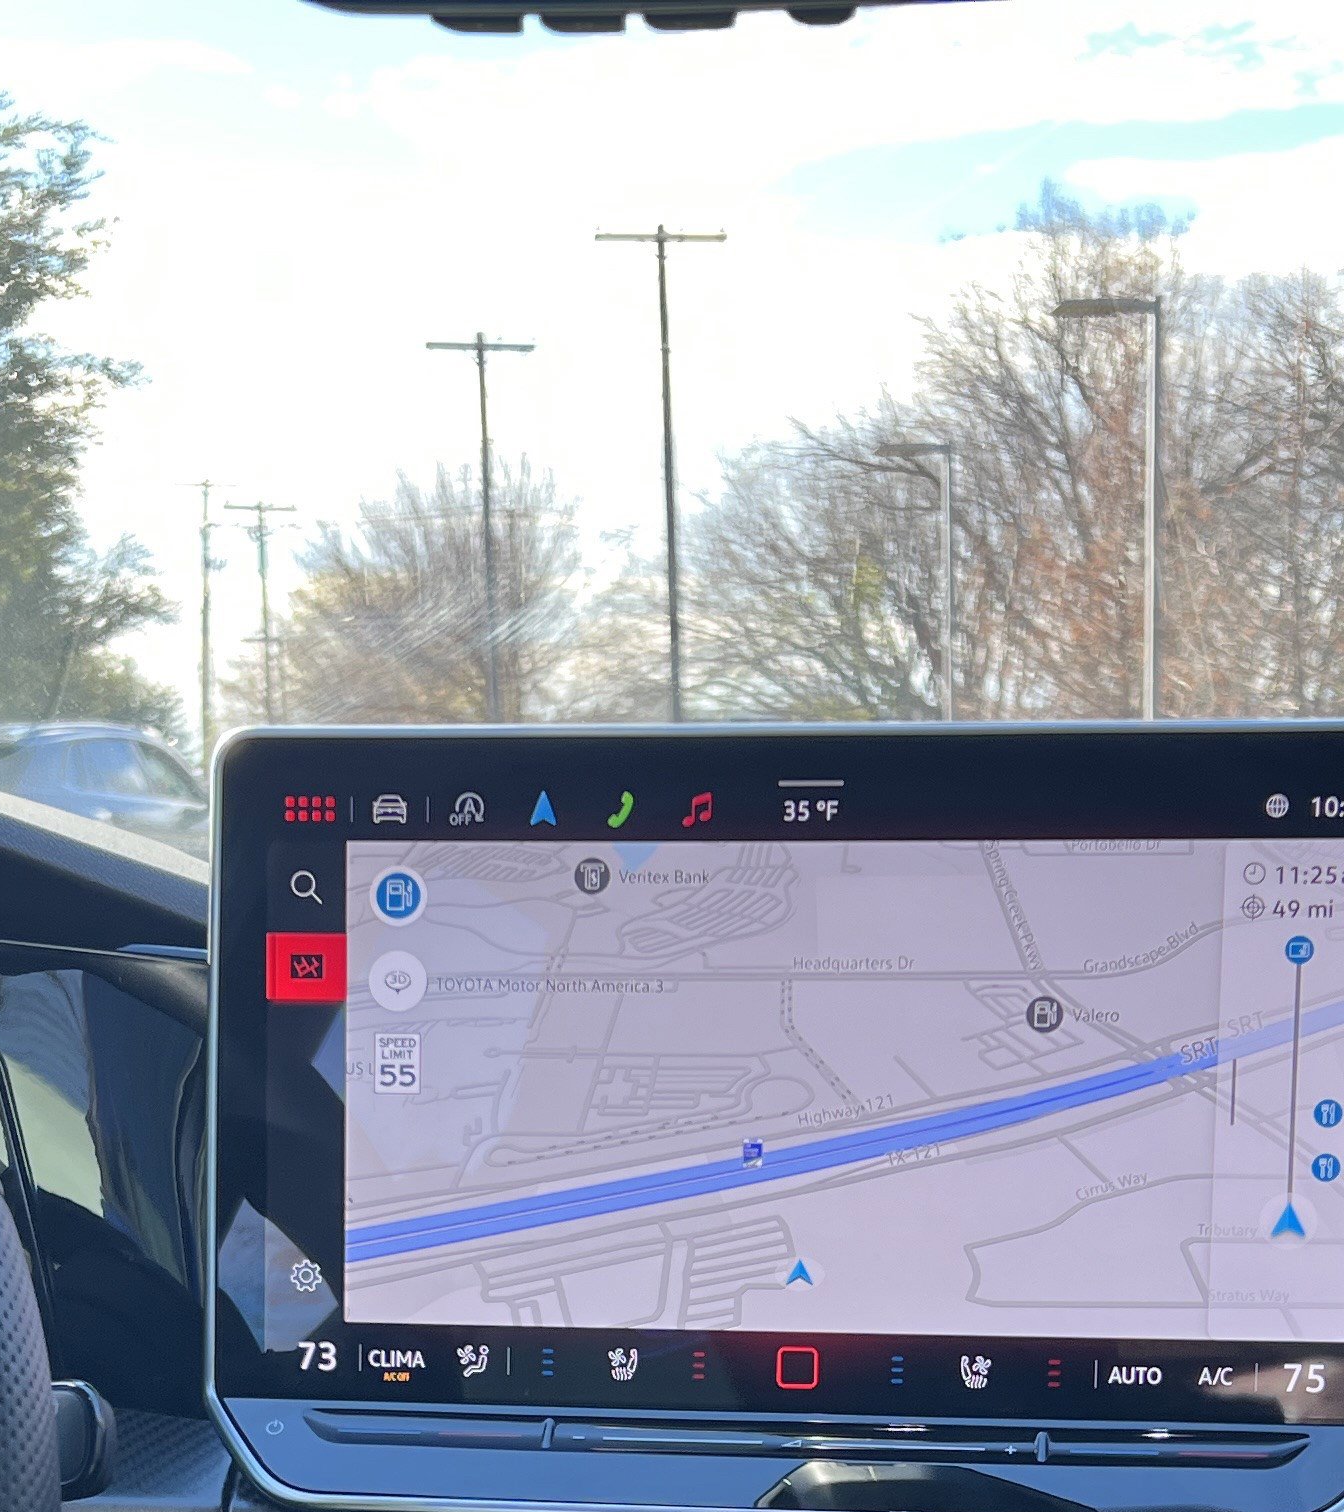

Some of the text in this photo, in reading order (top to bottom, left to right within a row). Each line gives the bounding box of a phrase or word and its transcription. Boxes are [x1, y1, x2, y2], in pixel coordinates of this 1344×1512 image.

[783, 800, 810, 822] 35
[618, 869, 710, 885] Veritex Bank
[1272, 899, 1334, 918] 49 mi
[1083, 921, 1200, 975] Grandscape Blvd
[793, 955, 916, 973] Headquarters Dr
[435, 976, 493, 992] TOYOTA
[497, 977, 540, 992] Motor
[545, 979, 587, 993] North
[591, 979, 650, 994] America
[1072, 1007, 1120, 1023] Valero
[1226, 1010, 1265, 1039] SRT
[378, 1037, 417, 1049] SPEED
[1180, 1036, 1218, 1065] SRT
[381, 1050, 414, 1061] LIMIT
[379, 1064, 417, 1088] 55
[797, 1103, 862, 1128] Highway
[1075, 1171, 1148, 1201] Cirrus Way
[1197, 1222, 1259, 1239] Tributary
[1207, 1288, 1290, 1304] Stratus Way
[297, 1340, 338, 1372] 73
[367, 1349, 426, 1369] CLIMA
[1108, 1366, 1163, 1386] AUTO
[1197, 1365, 1234, 1388] A/C
[1282, 1363, 1326, 1394] 75
